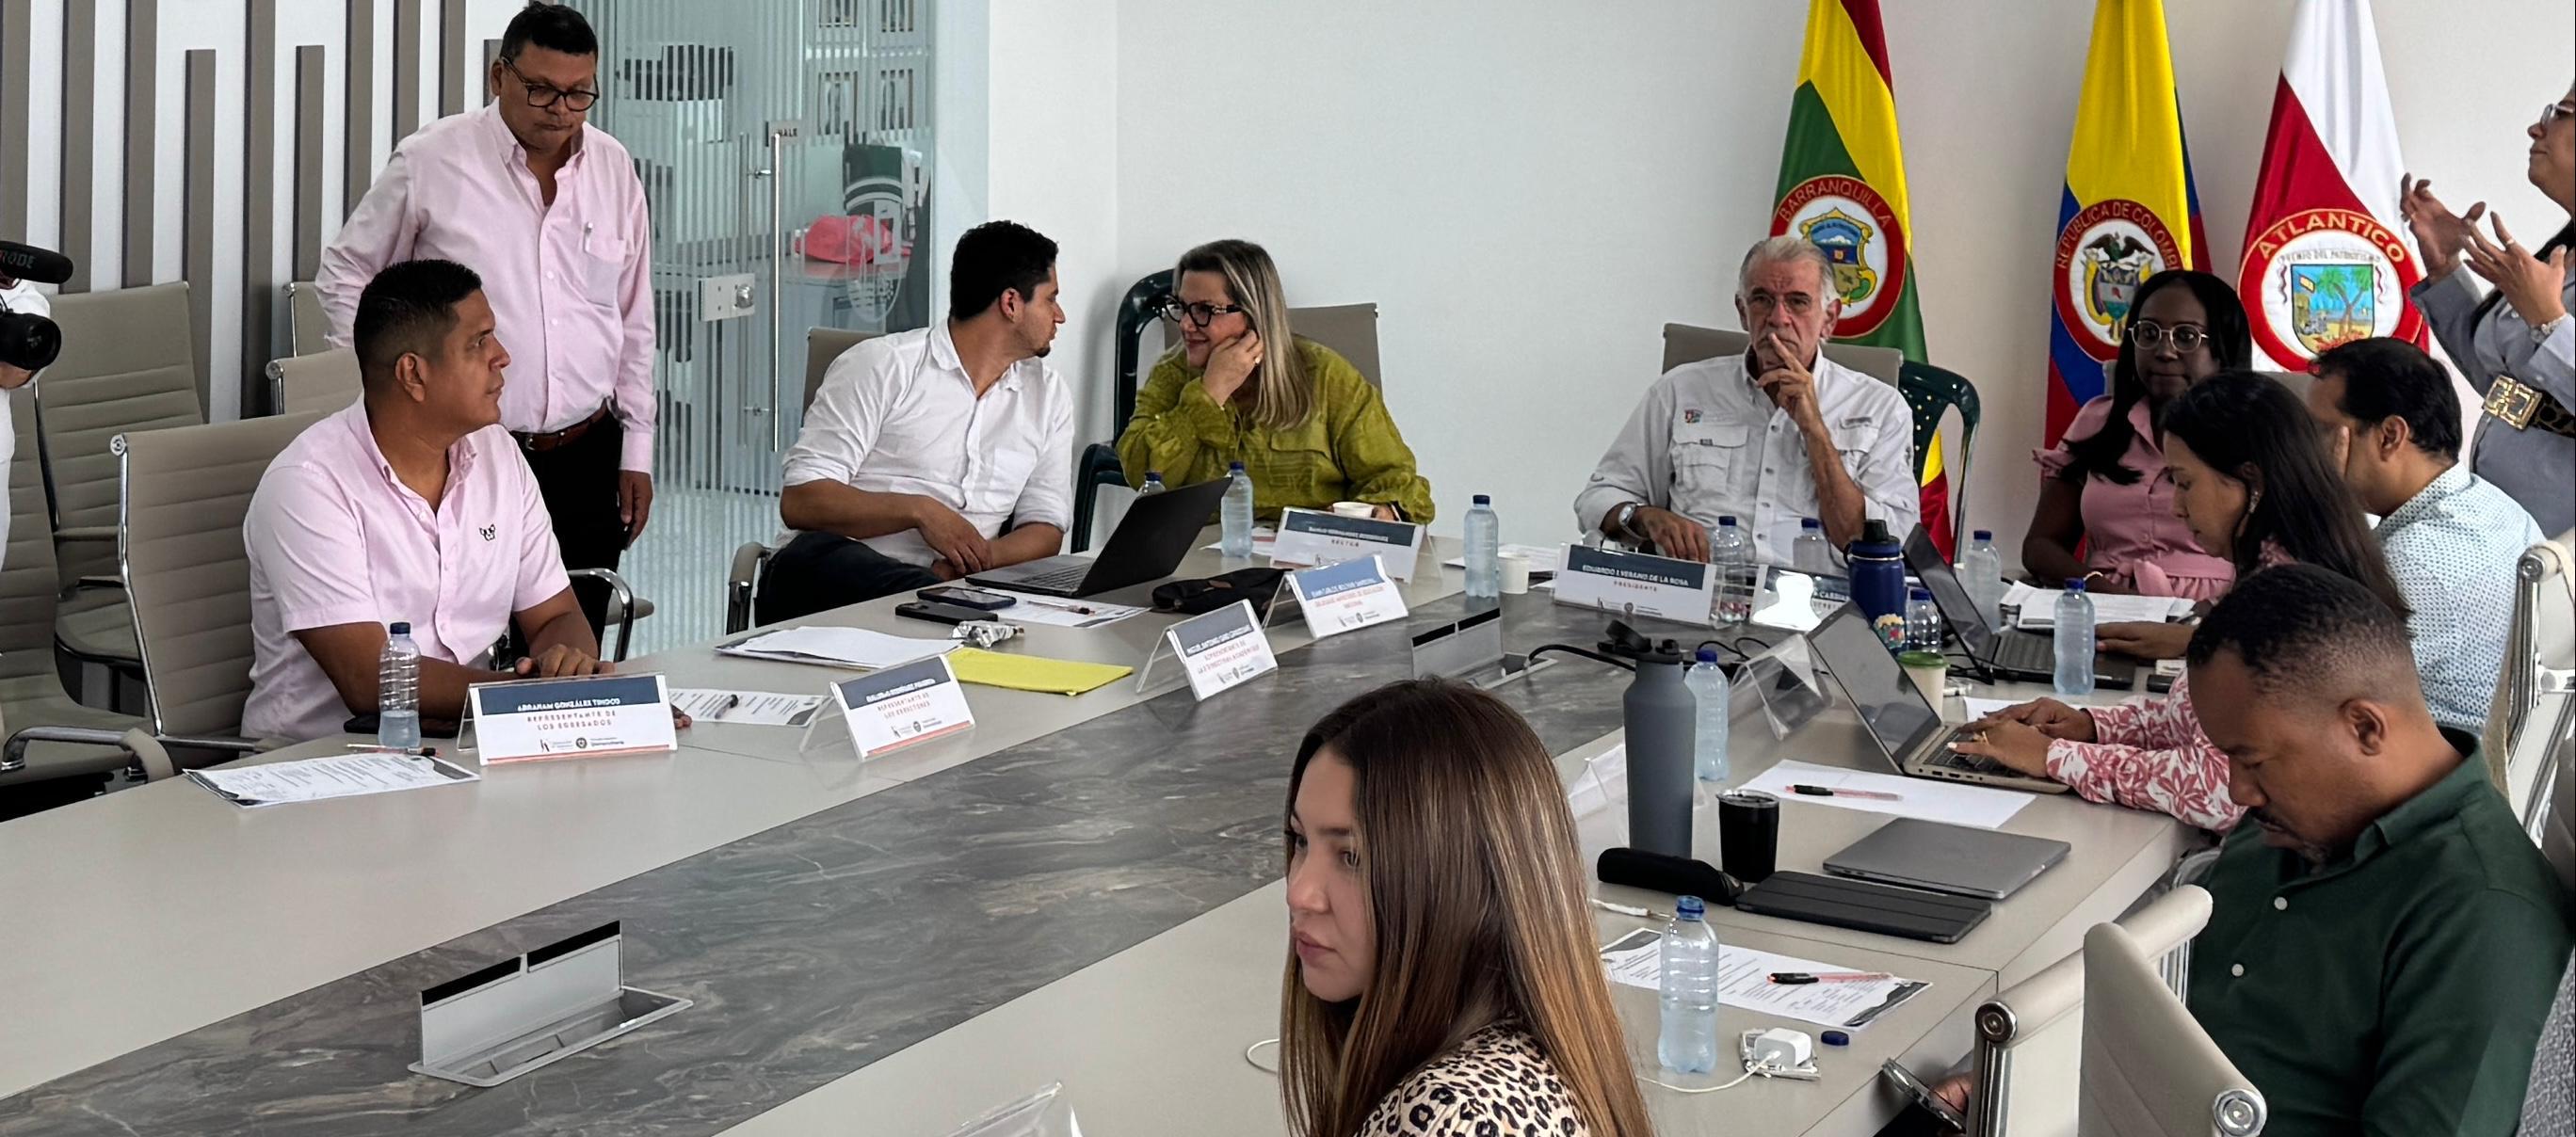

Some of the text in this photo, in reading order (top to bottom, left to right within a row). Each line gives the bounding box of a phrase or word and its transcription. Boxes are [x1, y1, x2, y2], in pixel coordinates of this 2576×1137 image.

[1779, 179, 1892, 229] BARRANQUILLA
[2056, 201, 2181, 271] REPUBLICA DE COLOMBI
[2257, 212, 2405, 264] ATLANTICO
[1582, 565, 1616, 575] EDUARDO
[1620, 570, 1649, 581] VERANO
[1669, 577, 1689, 586] ROSA
[517, 703, 554, 713] ABRAHAM
[592, 697, 621, 707] TINOCO
[527, 711, 602, 722] REPRESENTANTE
[537, 719, 612, 731] LOS EGRESADOS
